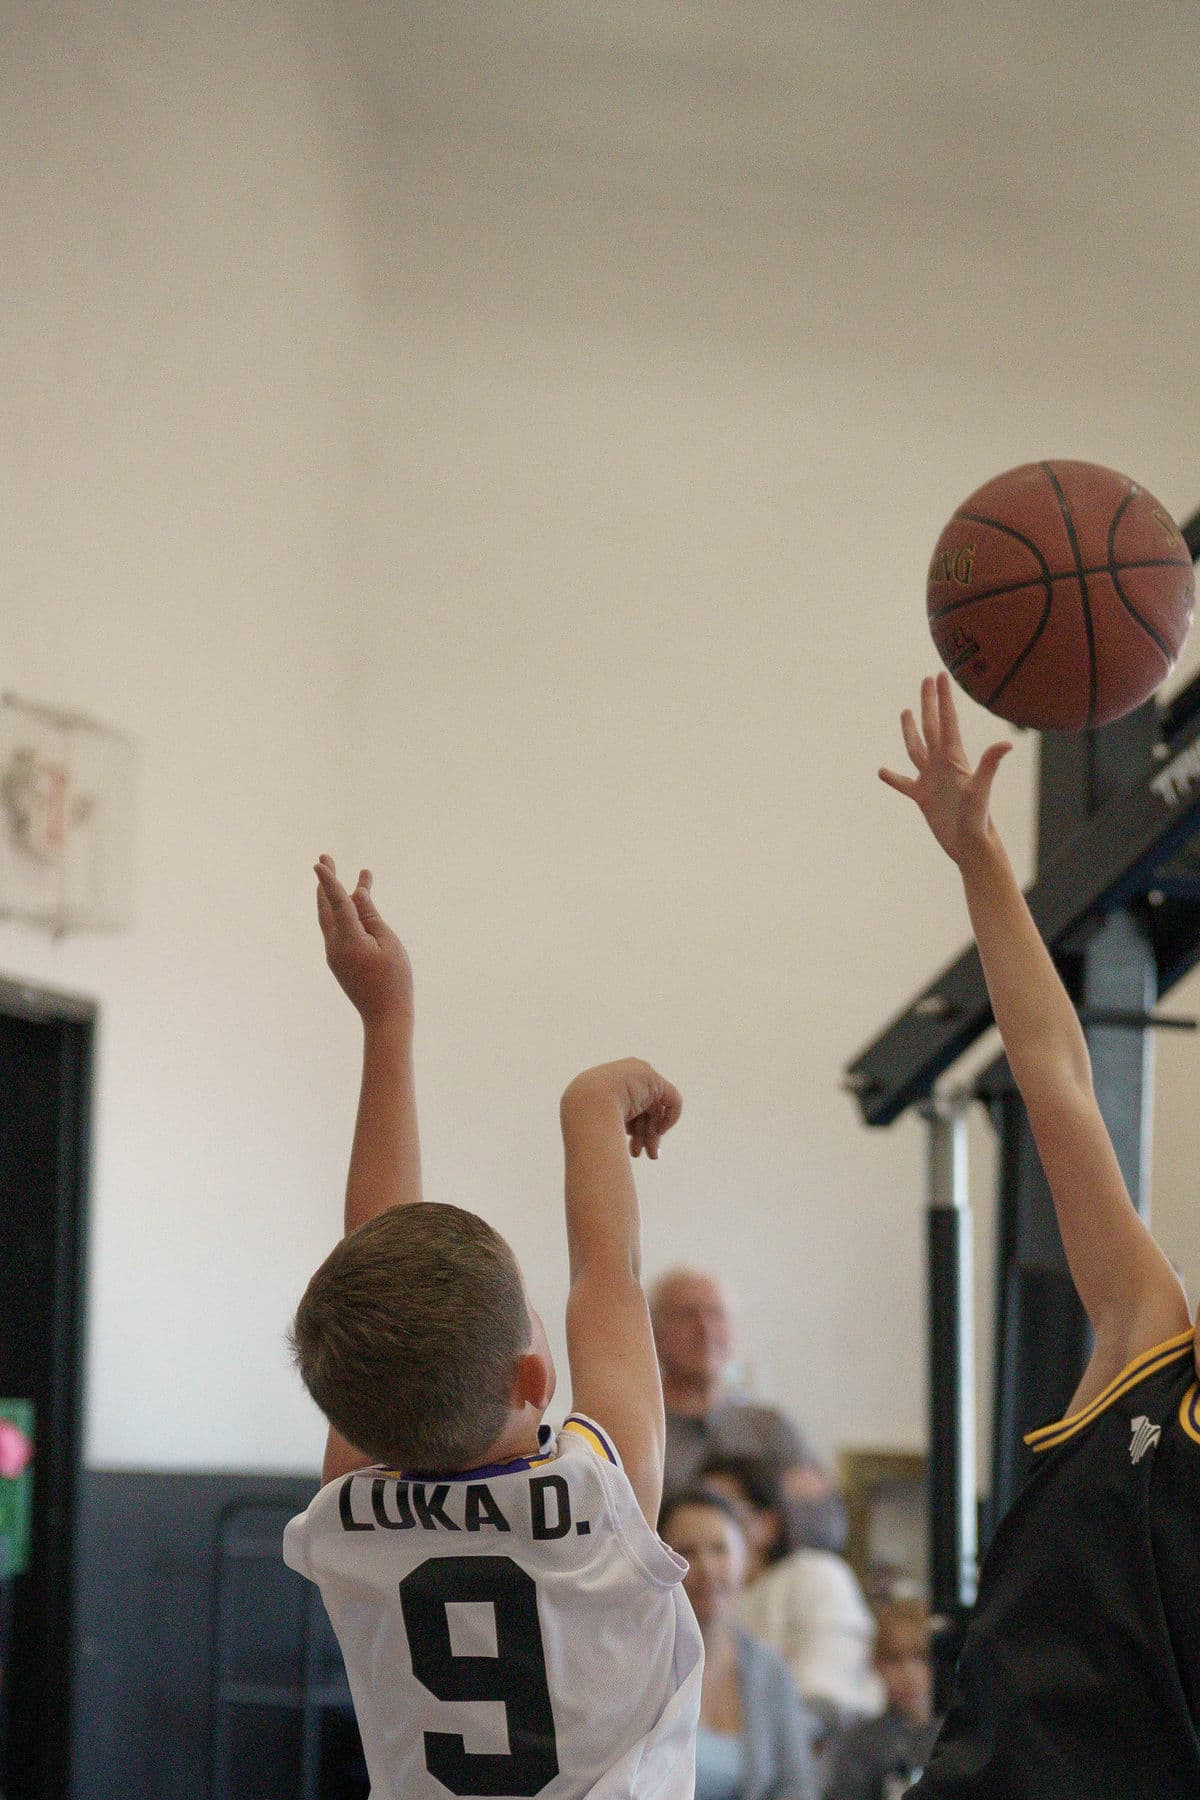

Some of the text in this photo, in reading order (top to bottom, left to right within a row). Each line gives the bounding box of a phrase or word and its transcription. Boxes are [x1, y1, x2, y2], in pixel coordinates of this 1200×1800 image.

[337, 1474, 592, 1541] LUKA D.
[398, 1555, 560, 1798] 9
